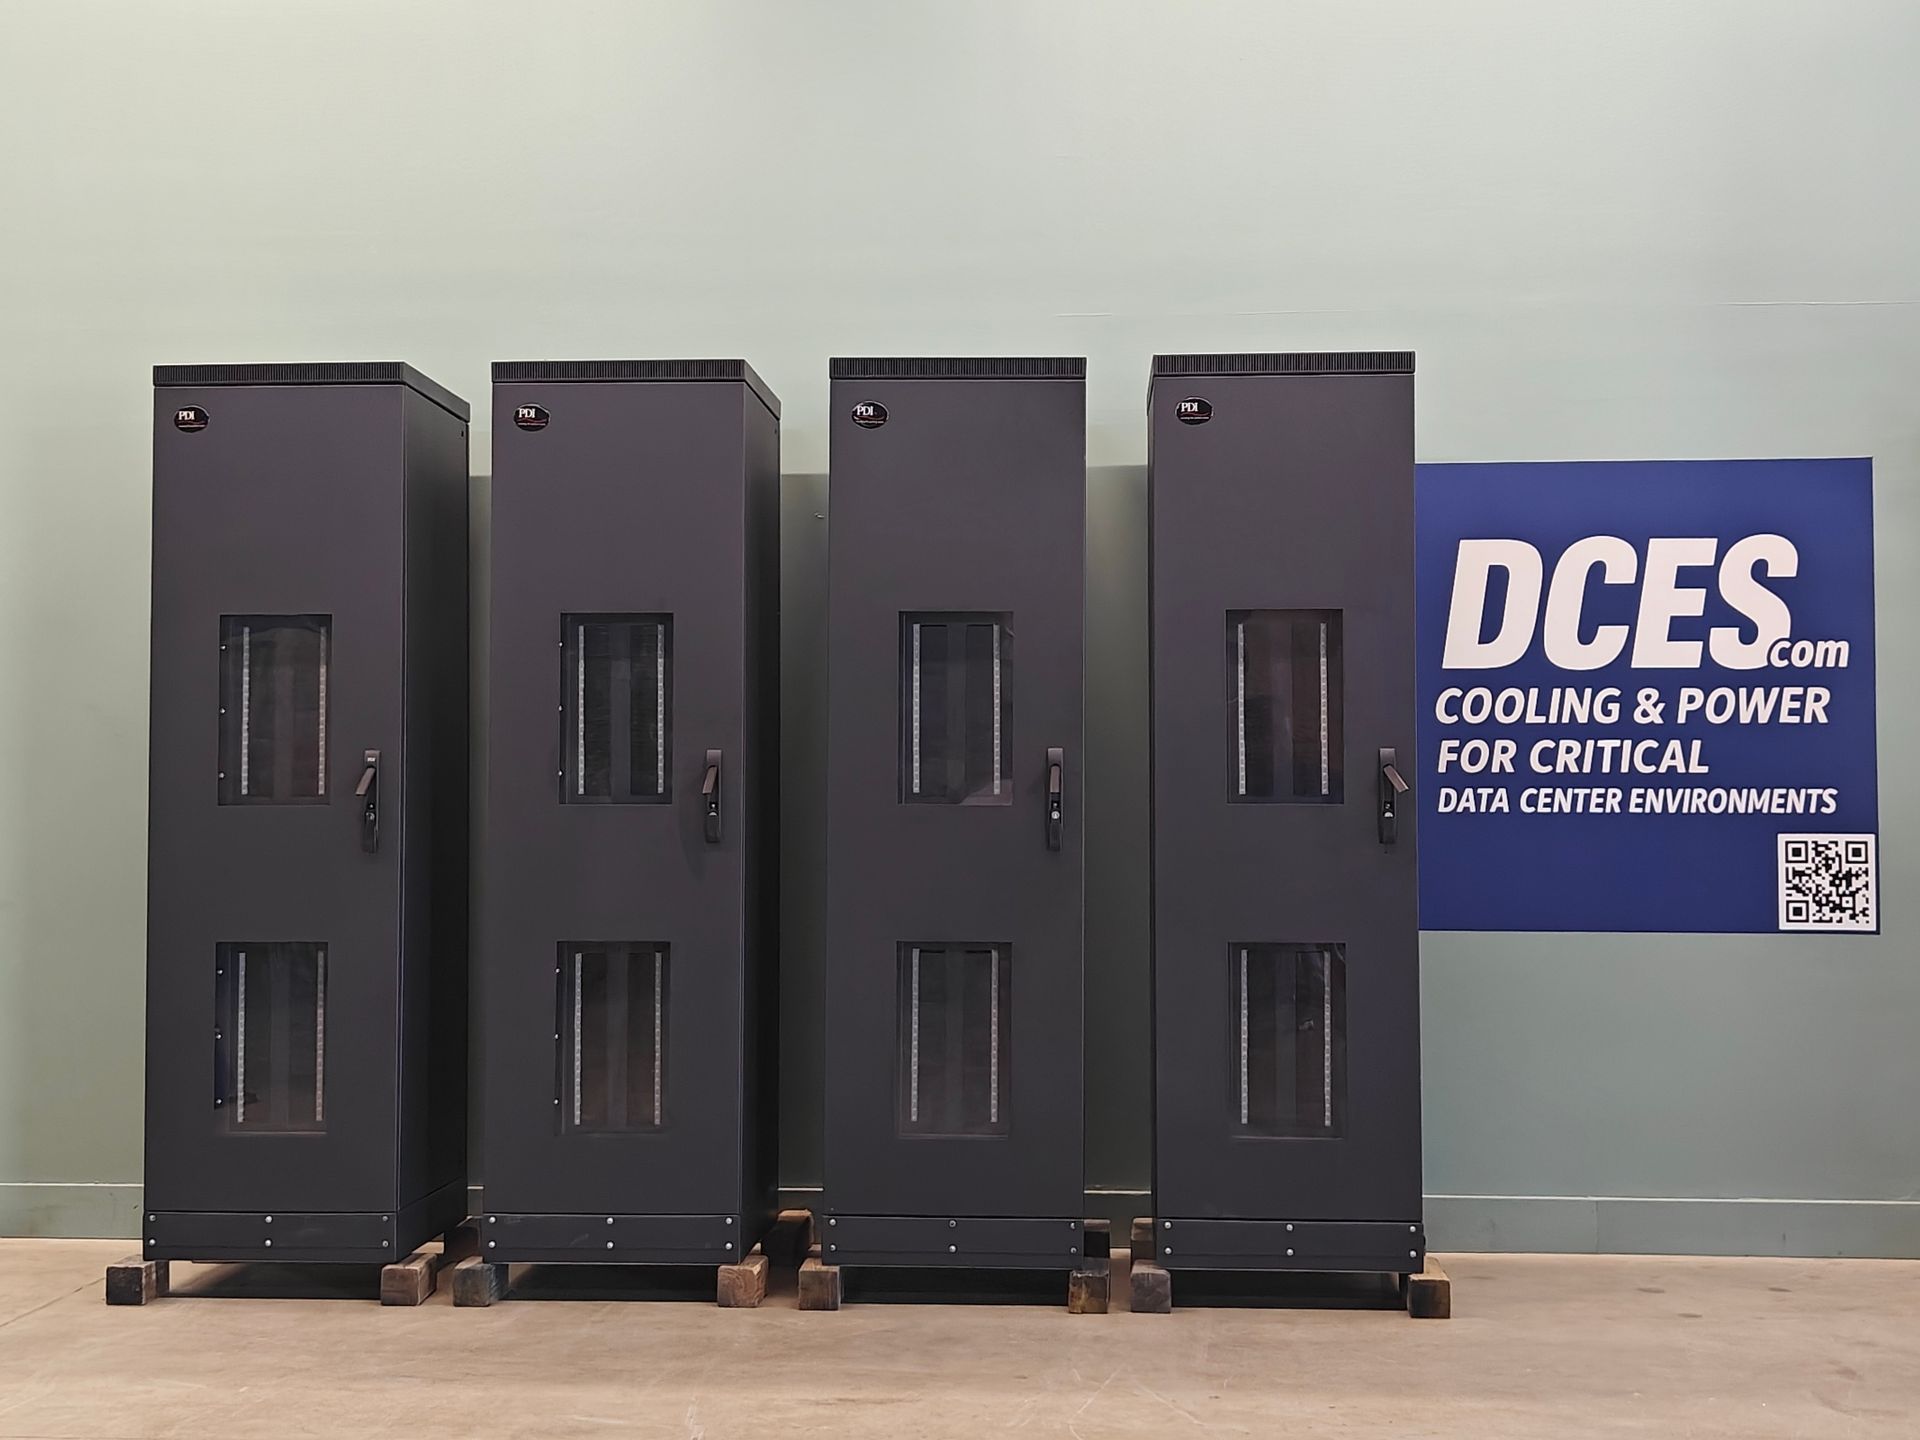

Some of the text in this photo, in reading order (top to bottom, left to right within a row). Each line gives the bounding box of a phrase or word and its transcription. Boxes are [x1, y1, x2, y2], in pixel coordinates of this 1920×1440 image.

[178, 410, 195, 421] PDI
[518, 407, 535, 419] PDI
[856, 404, 873, 416] PDI
[1181, 402, 1198, 412] PDI
[1442, 534, 1799, 671] DCES
[1769, 639, 1850, 668] com
[1435, 686, 1831, 725] COOLING & POWER
[1437, 739, 1710, 774] FOR CRITICAL
[1437, 787, 1839, 814] DATA CENTER ENVIRONMENTS
